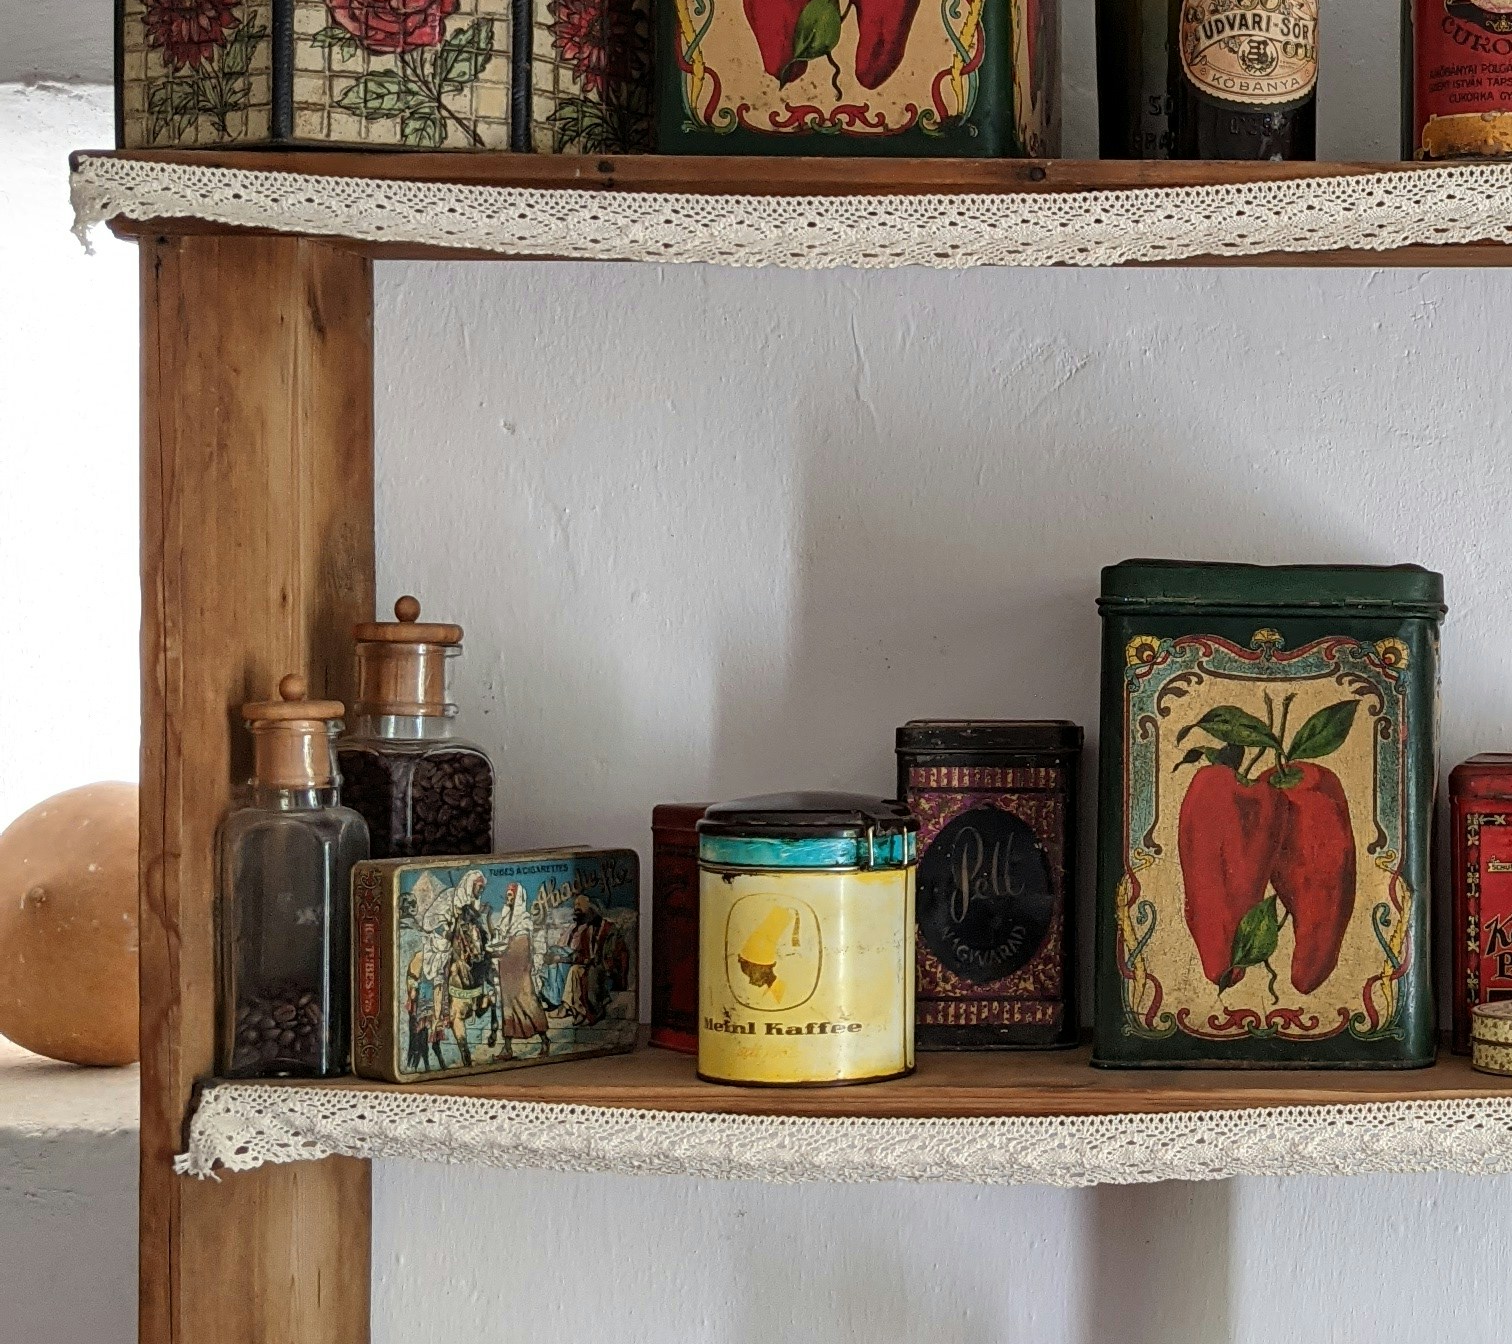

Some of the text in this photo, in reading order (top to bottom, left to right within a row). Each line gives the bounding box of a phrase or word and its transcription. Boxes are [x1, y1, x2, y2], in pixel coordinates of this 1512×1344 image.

[1202, 12, 1310, 41] UDVARI-SÖR
[1449, 91, 1495, 104] CUKORKA
[489, 865, 515, 877] TUBES
[764, 1021, 863, 1036] Kaffee
